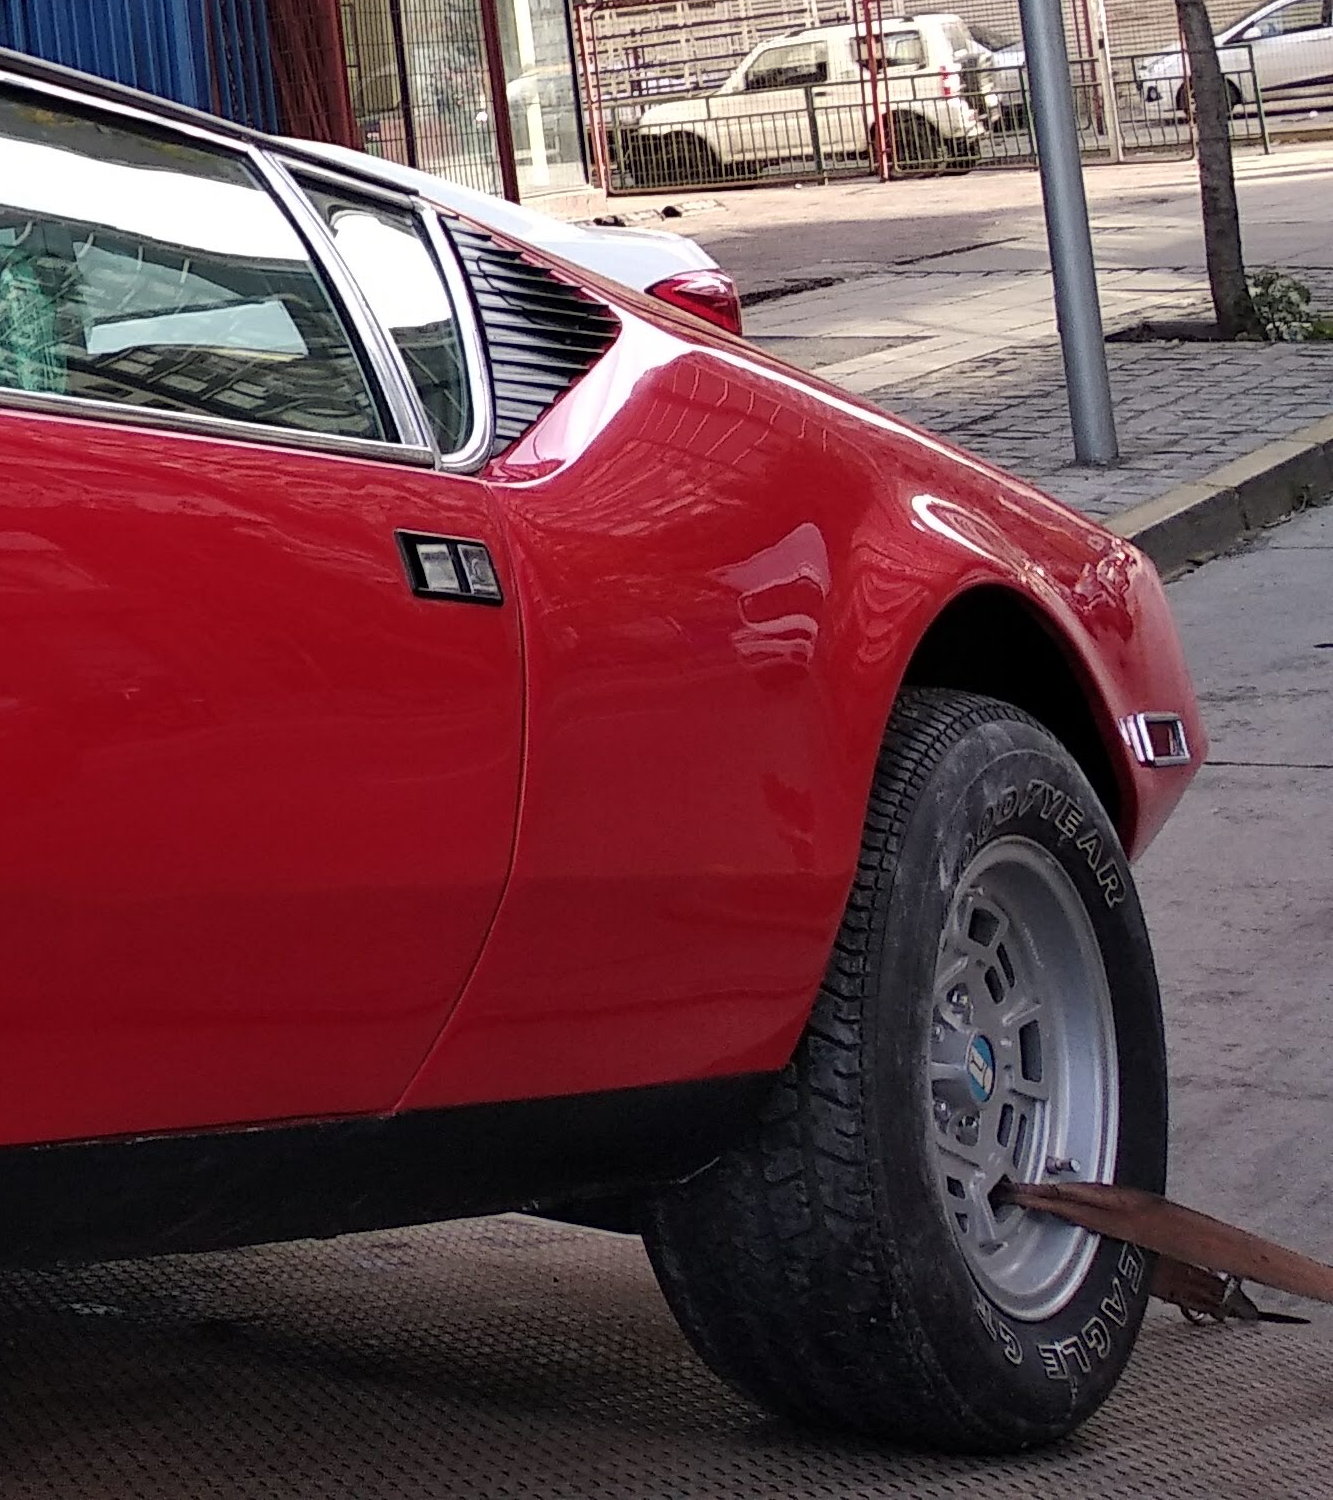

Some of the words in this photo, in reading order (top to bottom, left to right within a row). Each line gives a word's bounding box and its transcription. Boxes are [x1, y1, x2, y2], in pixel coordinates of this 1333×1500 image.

[958, 778, 1127, 909] OODYEAR
[975, 1298, 1024, 1367] GT
[1036, 1242, 1147, 1381] EAGLE
